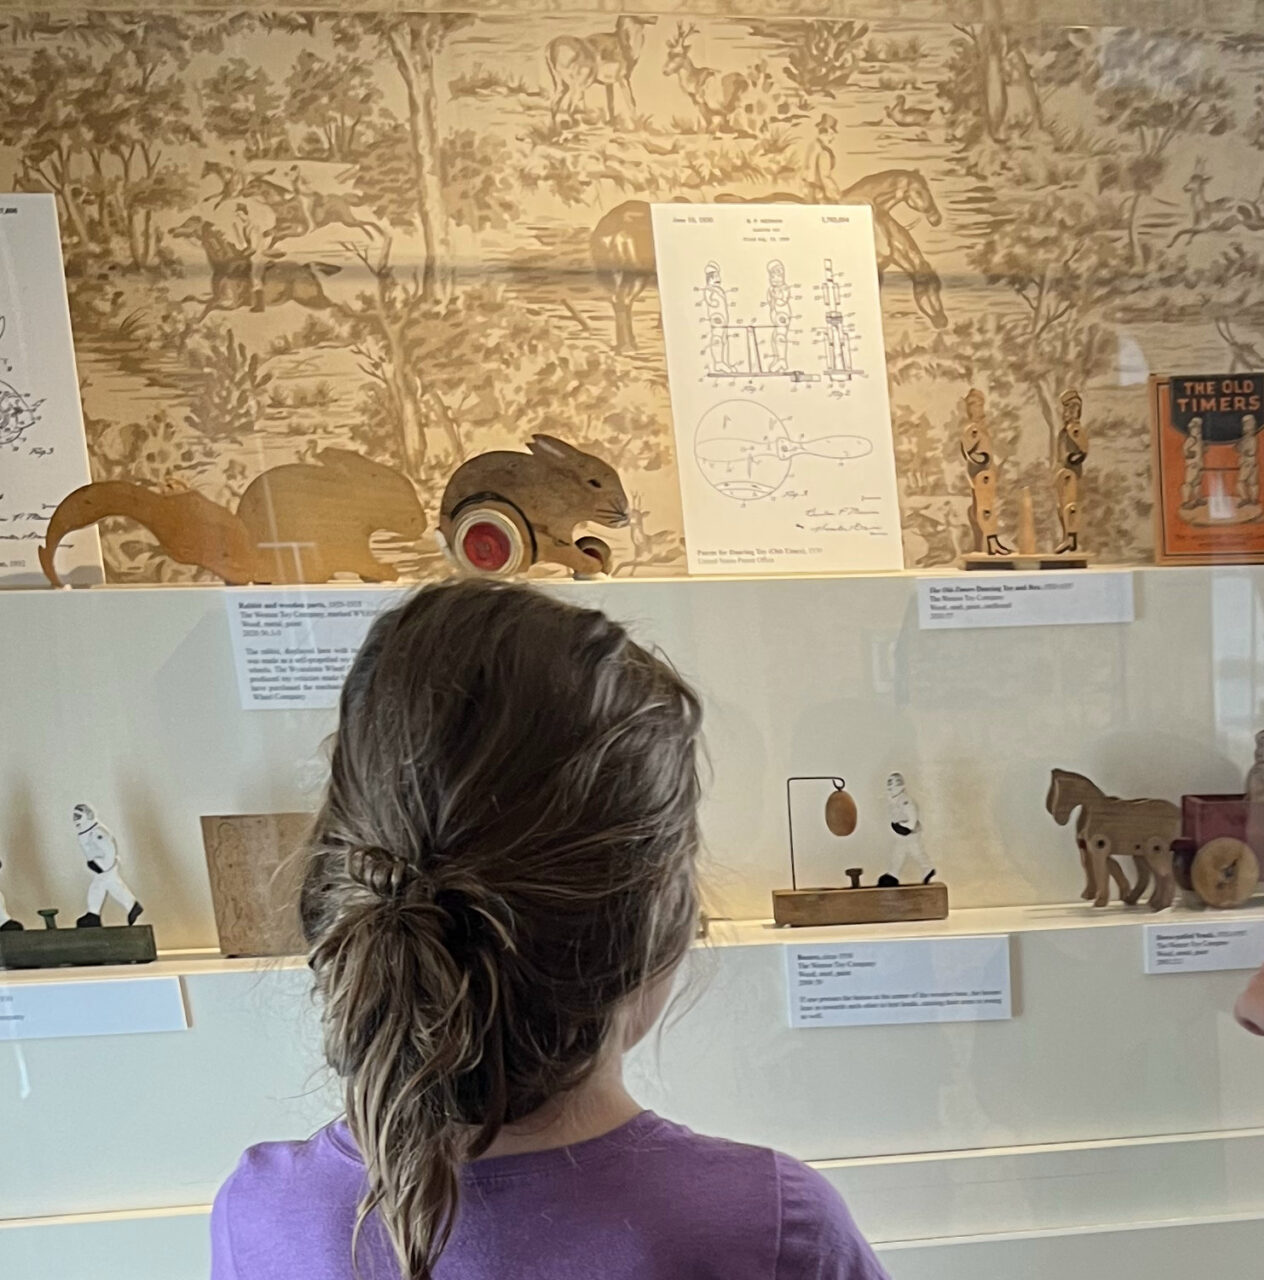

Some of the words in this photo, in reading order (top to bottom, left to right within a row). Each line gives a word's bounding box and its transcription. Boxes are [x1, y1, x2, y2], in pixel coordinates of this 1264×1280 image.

[1184, 381, 1216, 396] THE
[1222, 379, 1254, 395] OLD
[1177, 395, 1261, 413] TIMERS
